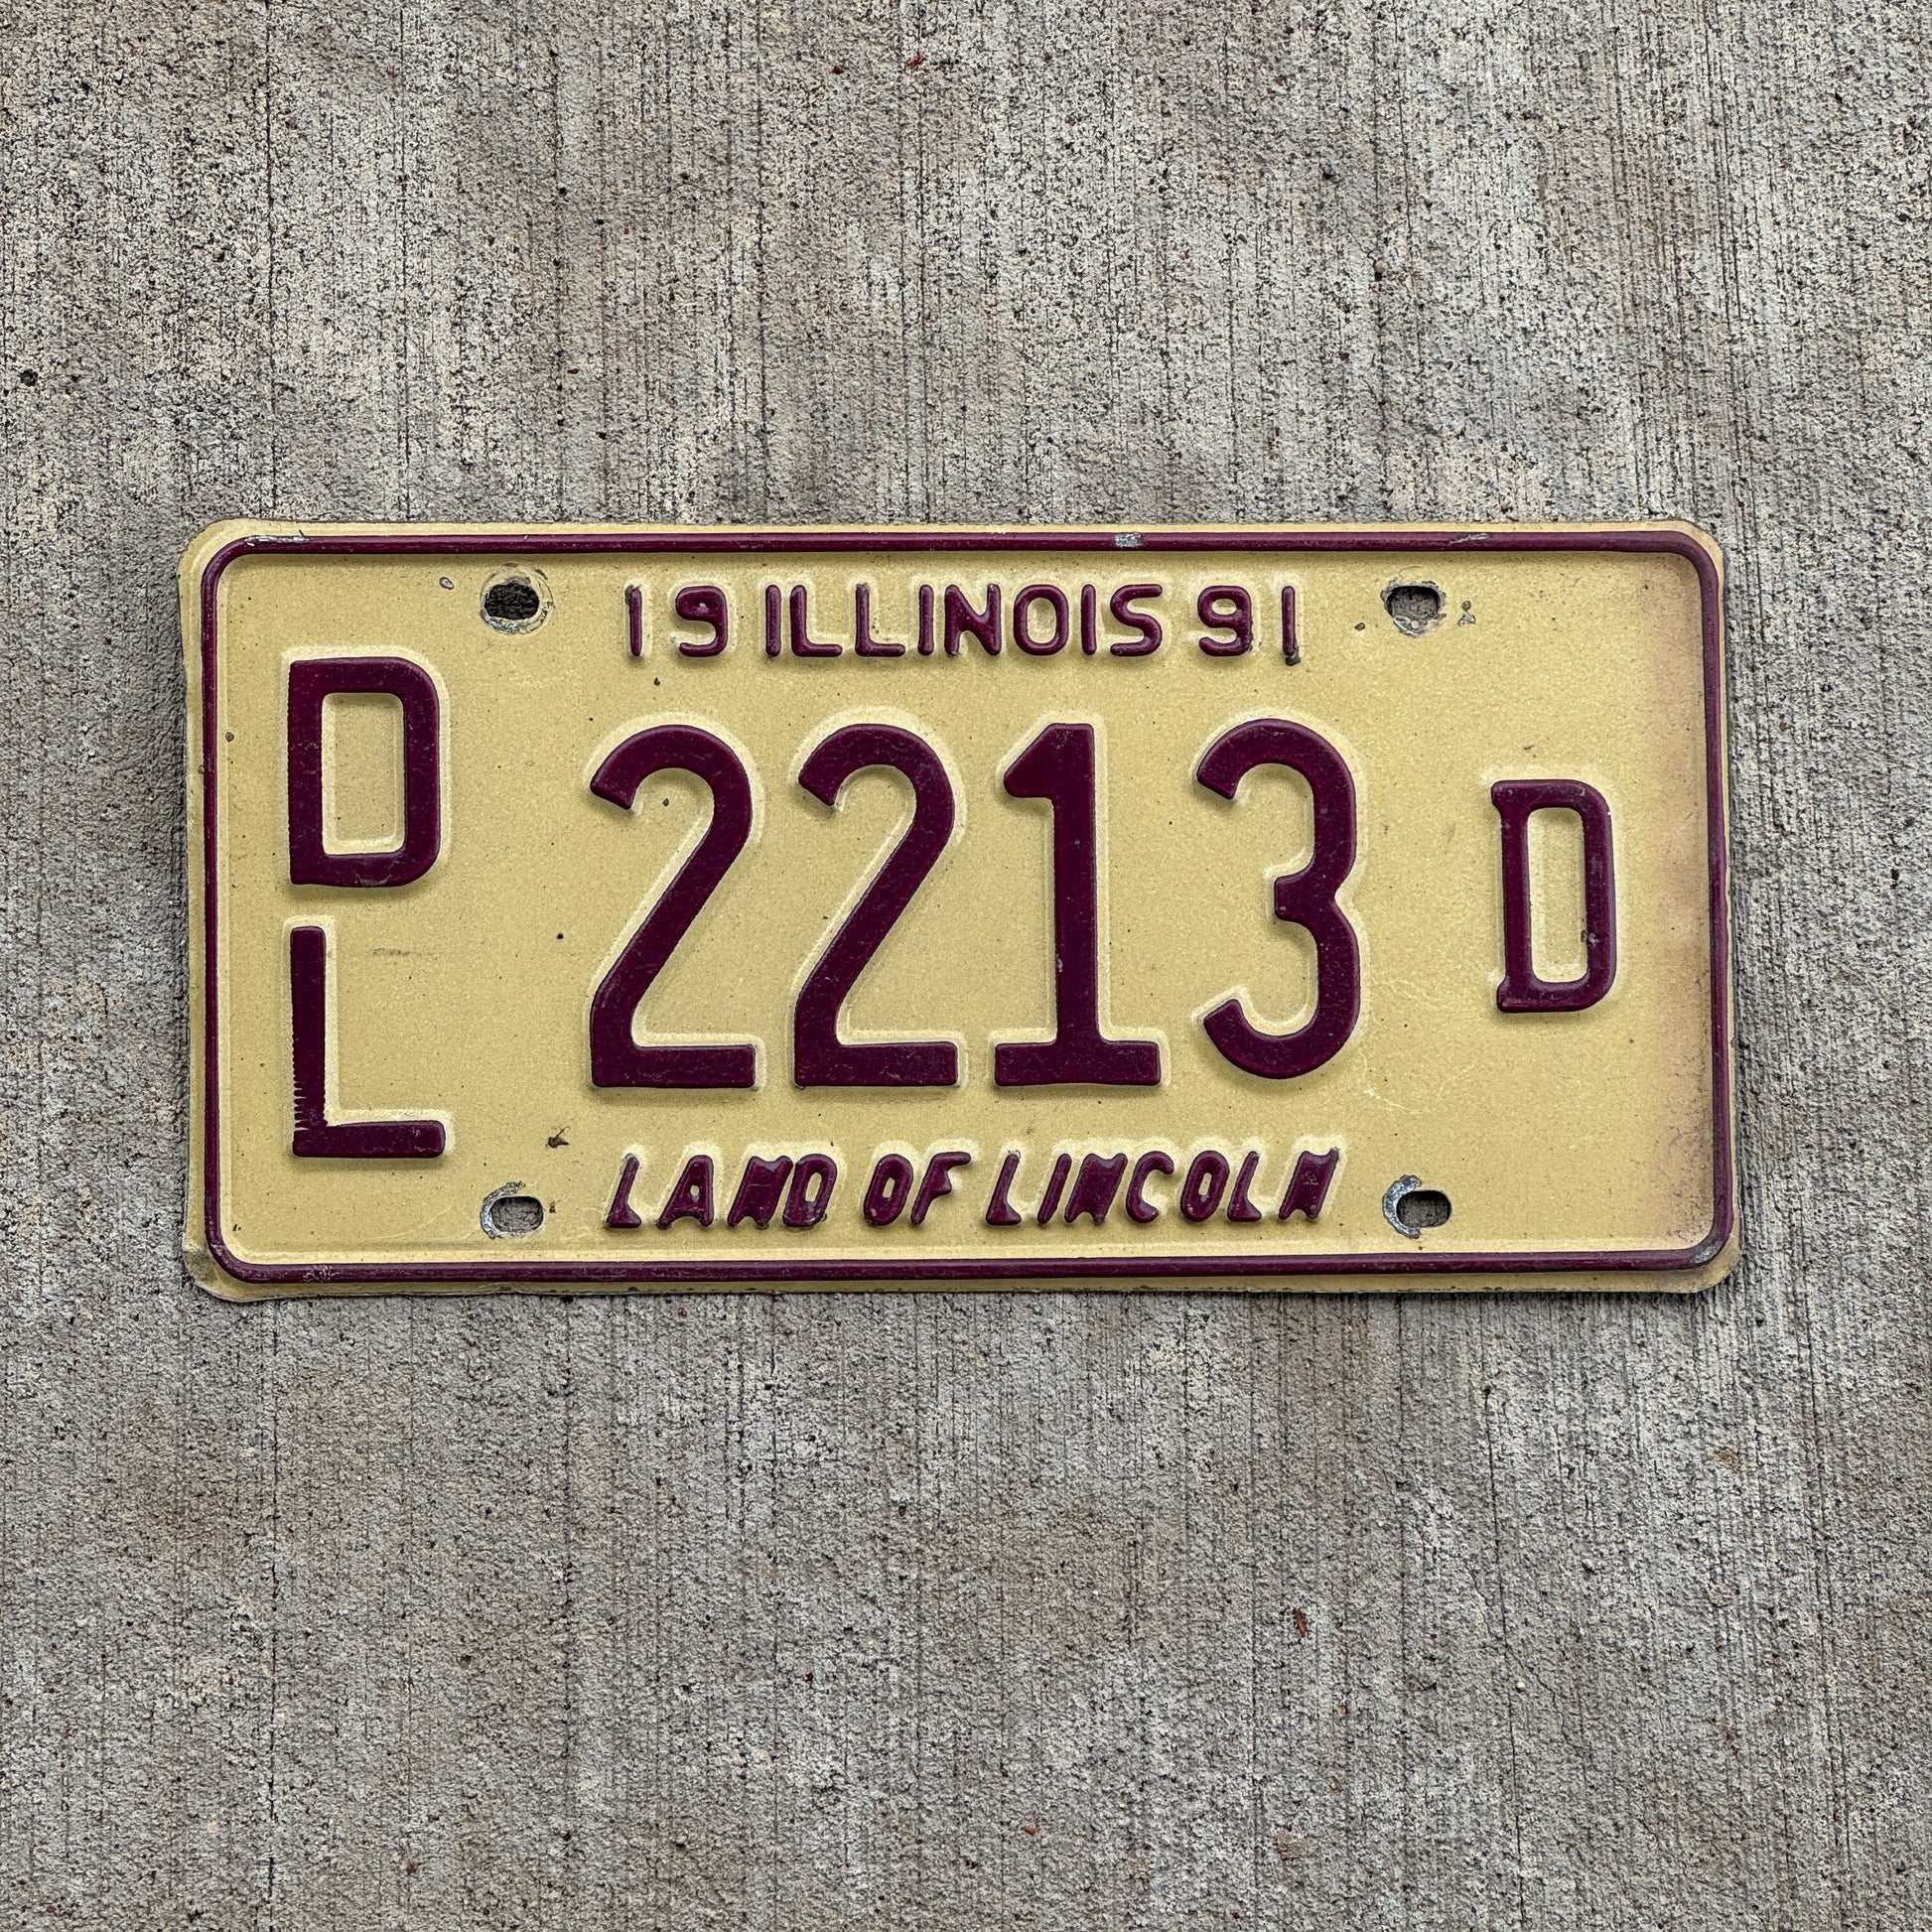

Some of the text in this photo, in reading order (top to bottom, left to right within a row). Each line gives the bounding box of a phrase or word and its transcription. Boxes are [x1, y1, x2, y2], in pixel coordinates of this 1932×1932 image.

[626, 583, 1299, 663] 19 ILLINOIS 91
[589, 721, 1362, 1089] 2213
[1490, 778, 1613, 1014] D
[606, 1148, 1340, 1230] LAND OF LINCOLN
